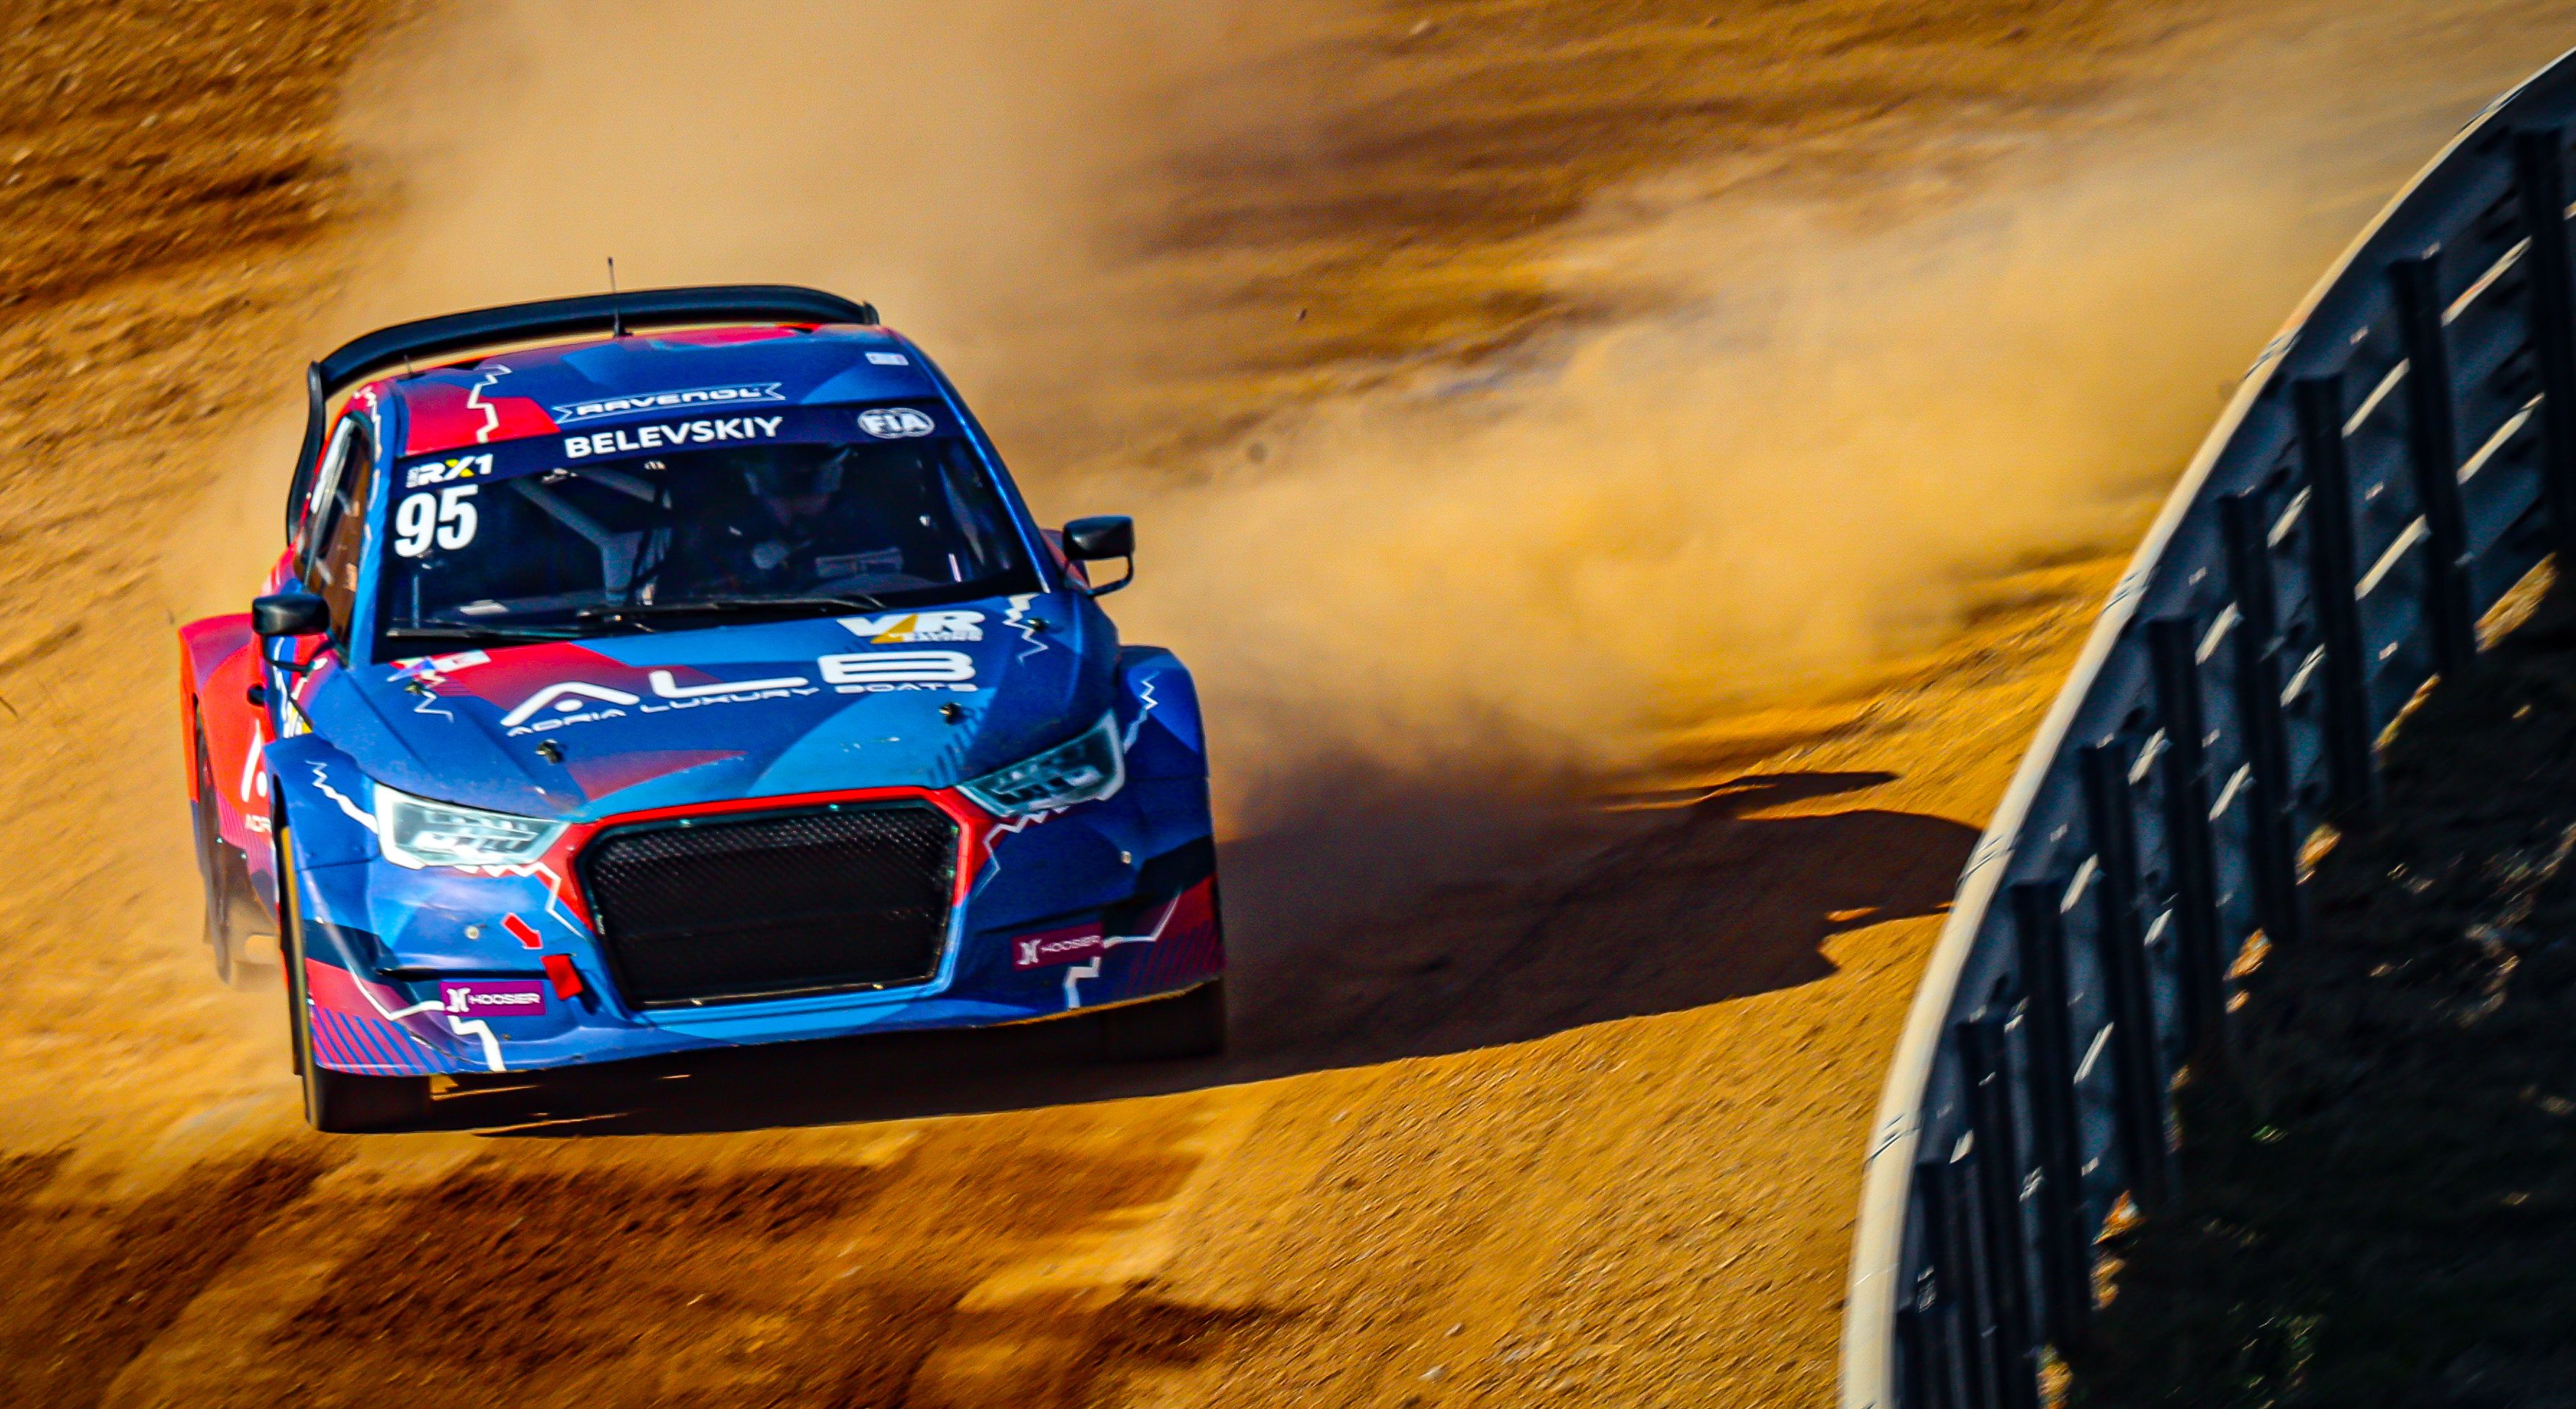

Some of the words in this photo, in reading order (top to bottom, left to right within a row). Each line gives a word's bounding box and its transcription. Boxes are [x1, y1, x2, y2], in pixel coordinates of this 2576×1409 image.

[577, 387, 762, 415] RAVENOL
[564, 415, 783, 459] BELEVSKIY
[863, 413, 929, 433] FIA
[394, 483, 478, 557] 95
[506, 708, 626, 737] ADRIA
[639, 686, 820, 713] LUXURY
[834, 683, 978, 694] BOATS
[467, 992, 541, 1005] HOOSIER
